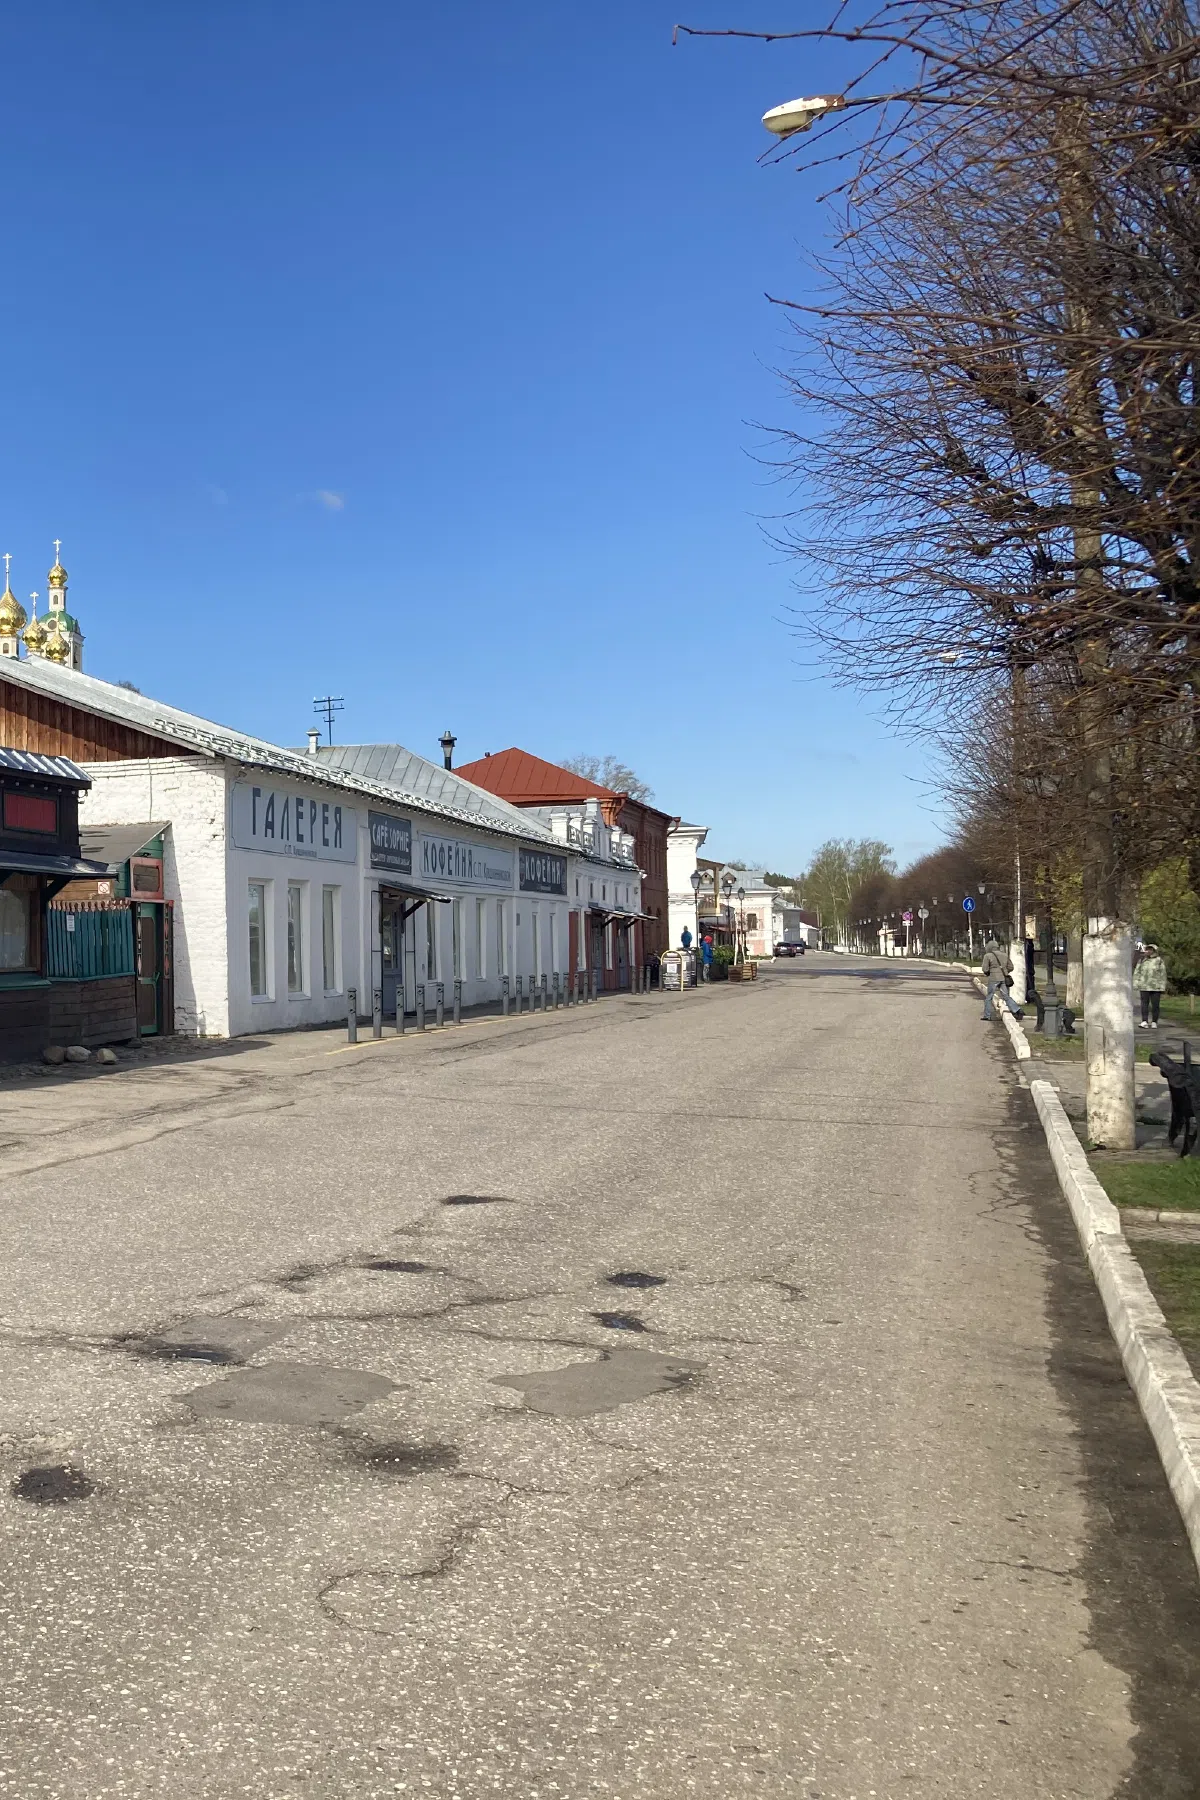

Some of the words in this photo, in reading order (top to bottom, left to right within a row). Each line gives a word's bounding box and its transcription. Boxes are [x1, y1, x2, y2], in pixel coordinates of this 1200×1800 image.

[252, 787, 342, 849] ГАЛЕРЕЯ
[372, 820, 388, 848] CAFÉ
[390, 828, 409, 852] SOPHIE
[423, 841, 472, 878] КОФЕЙНЯ
[525, 856, 561, 884] КОФЕЙНЯ
